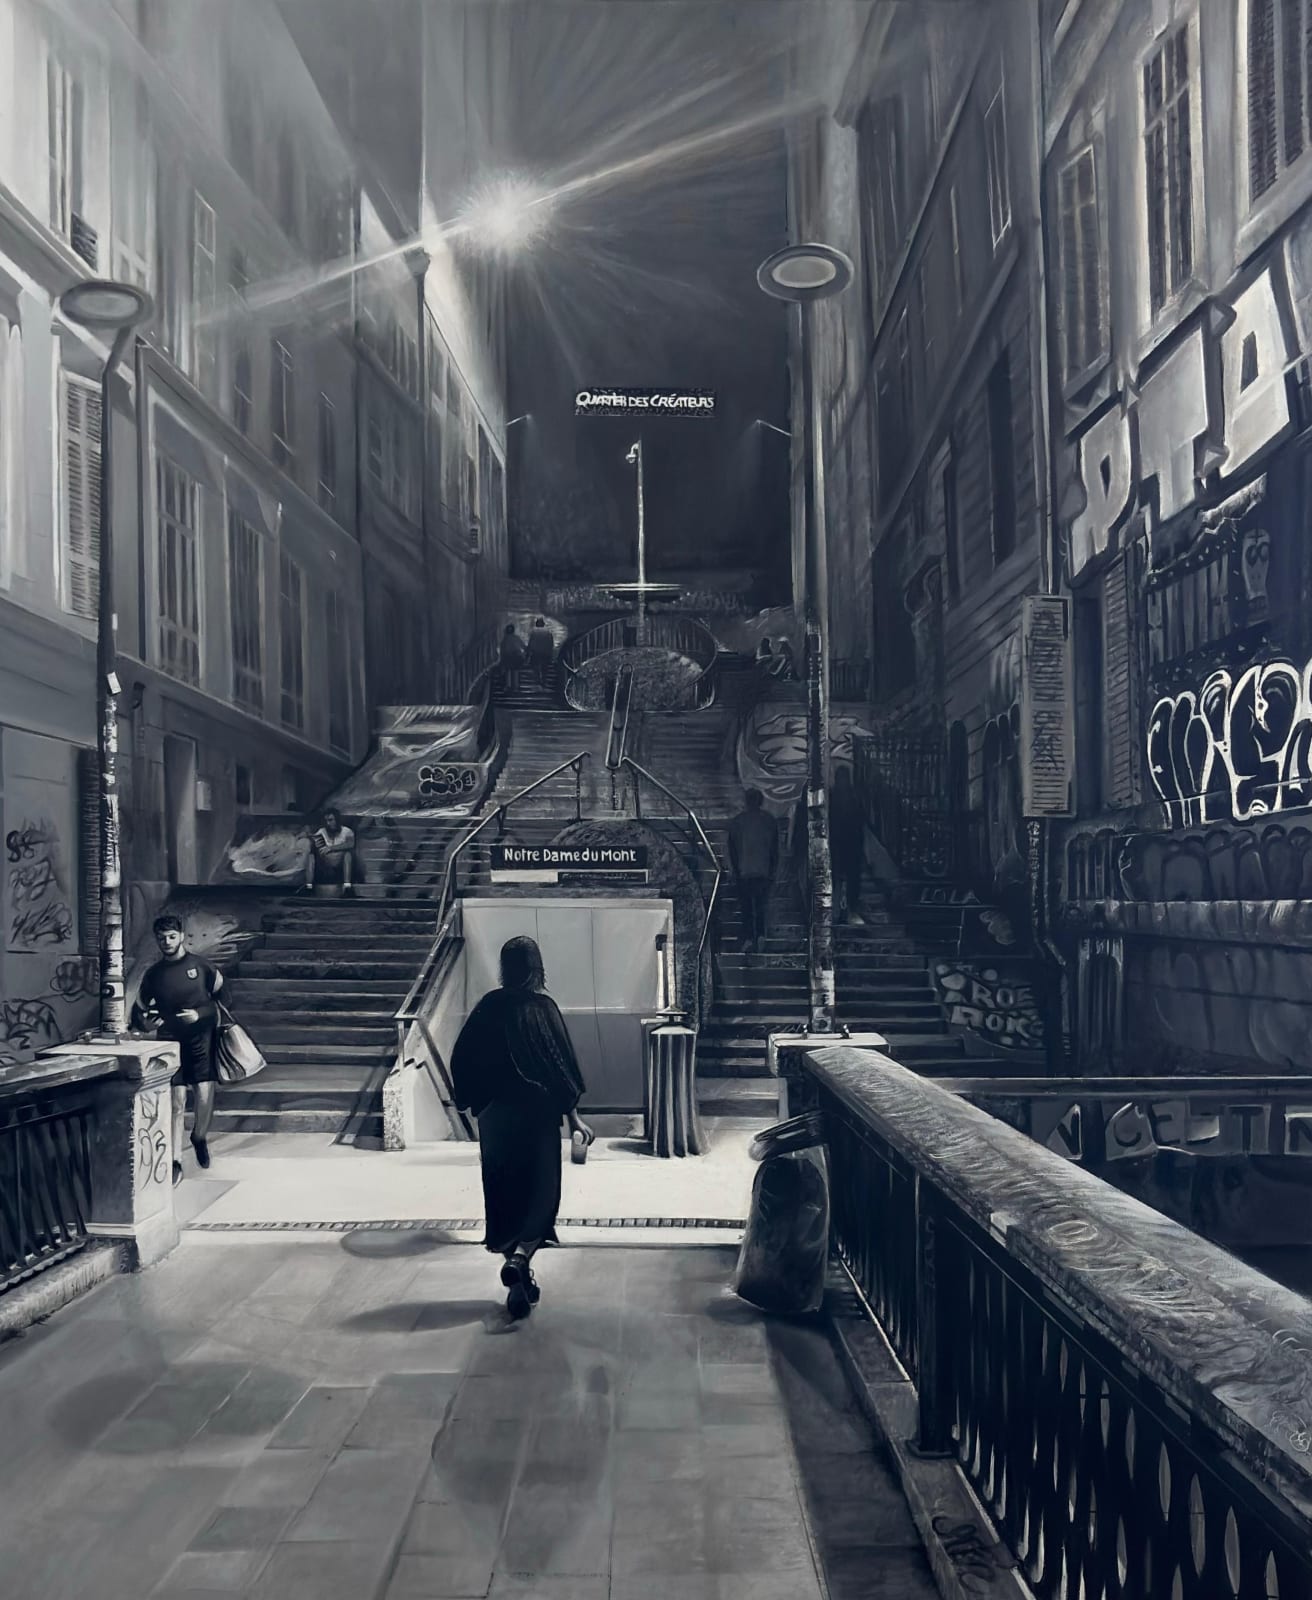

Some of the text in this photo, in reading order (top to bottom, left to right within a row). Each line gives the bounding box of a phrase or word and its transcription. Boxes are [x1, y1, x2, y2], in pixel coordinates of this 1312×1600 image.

[628, 396, 649, 407] DES
[650, 393, 714, 408] CRÉATEURS
[504, 848, 637, 861] Notre Dame du Mont
